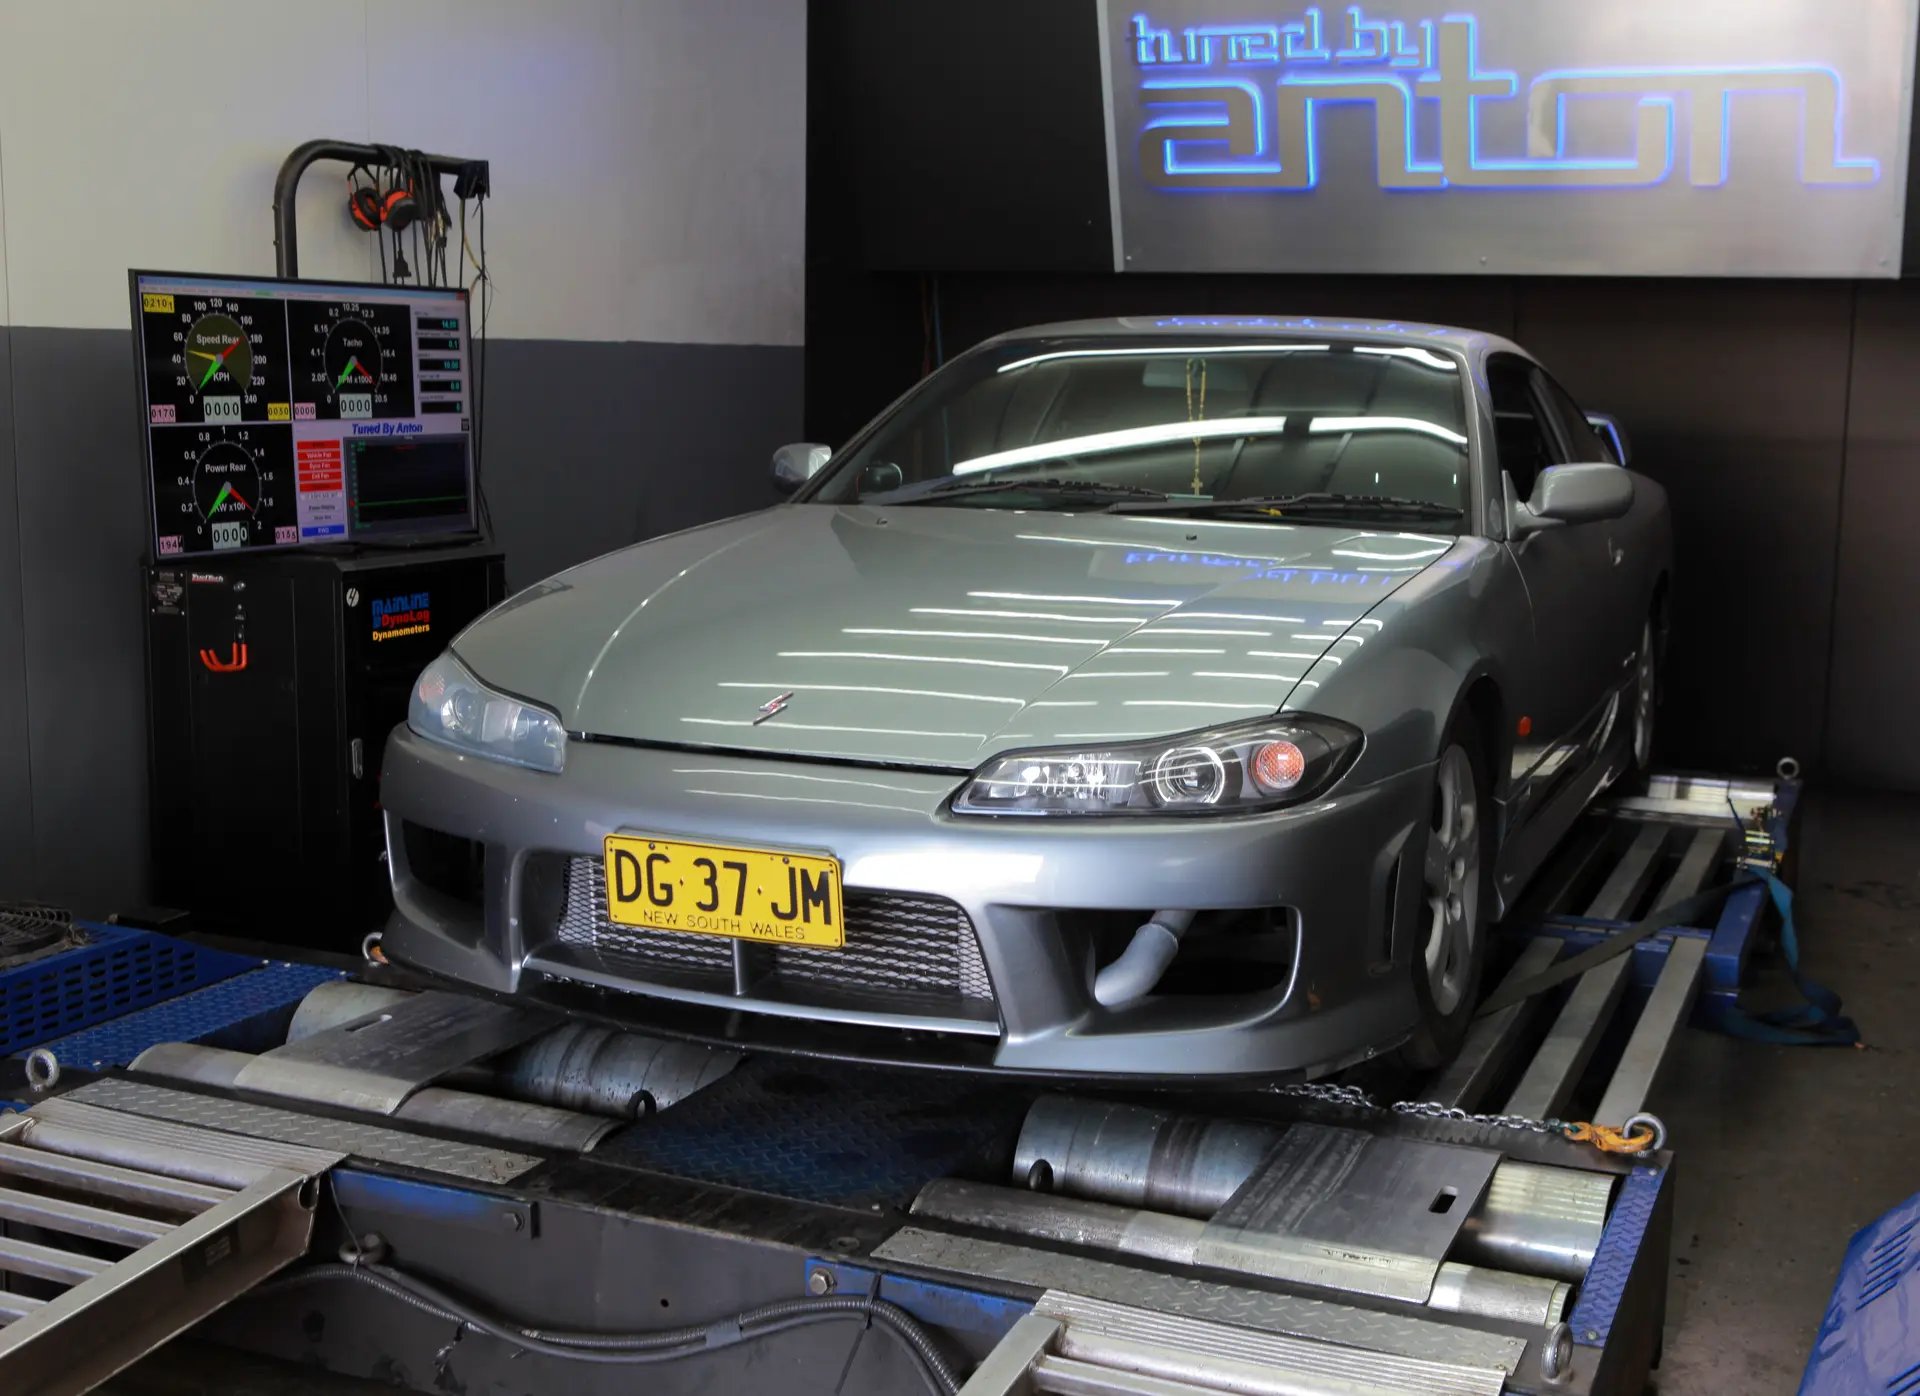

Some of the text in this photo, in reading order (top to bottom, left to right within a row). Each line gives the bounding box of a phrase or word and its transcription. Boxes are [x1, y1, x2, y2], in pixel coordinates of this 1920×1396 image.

[1132, 6, 1434, 70] tuned by
[1138, 13, 1880, 190] anton
[194, 302, 207, 312] 100
[210, 298, 223, 308] 120
[226, 303, 239, 313] 140
[342, 302, 360, 312] 10.25
[181, 313, 192, 324] 80
[361, 309, 375, 319] 12.3
[240, 315, 253, 325] 160
[173, 332, 183, 342] 60
[196, 333, 220, 346] Speed
[250, 334, 263, 344] 180
[342, 337, 363, 348] Tacho
[310, 347, 321, 357] 4.1
[171, 354, 182, 364] 40
[253, 355, 267, 365] 200
[176, 376, 186, 386] 20
[213, 372, 230, 382] KPH
[252, 376, 265, 386] 220
[311, 372, 326, 383] 2.05
[189, 395, 195, 405] 0
[244, 394, 258, 405] 240
[205, 402, 240, 416] 0000
[295, 406, 315, 415] 0000
[341, 400, 371, 412] 0000
[151, 408, 175, 418] 0170
[352, 421, 424, 436] Tuned By Anton
[199, 432, 211, 442] 0.8
[238, 431, 250, 441] 1.2
[184, 451, 196, 460] 0.6
[254, 448, 266, 457] 1.4
[205, 463, 248, 474] Power Rear
[177, 476, 190, 486] 0.4
[263, 471, 274, 481] 1.6
[181, 502, 193, 513] 0.2
[229, 501, 246, 512] x100
[382, 609, 431, 629] DynoLog
[372, 624, 431, 642] Dynamometers
[614, 849, 832, 926] DG 37 JM
[643, 908, 805, 940] NEW SOUTH WALES
